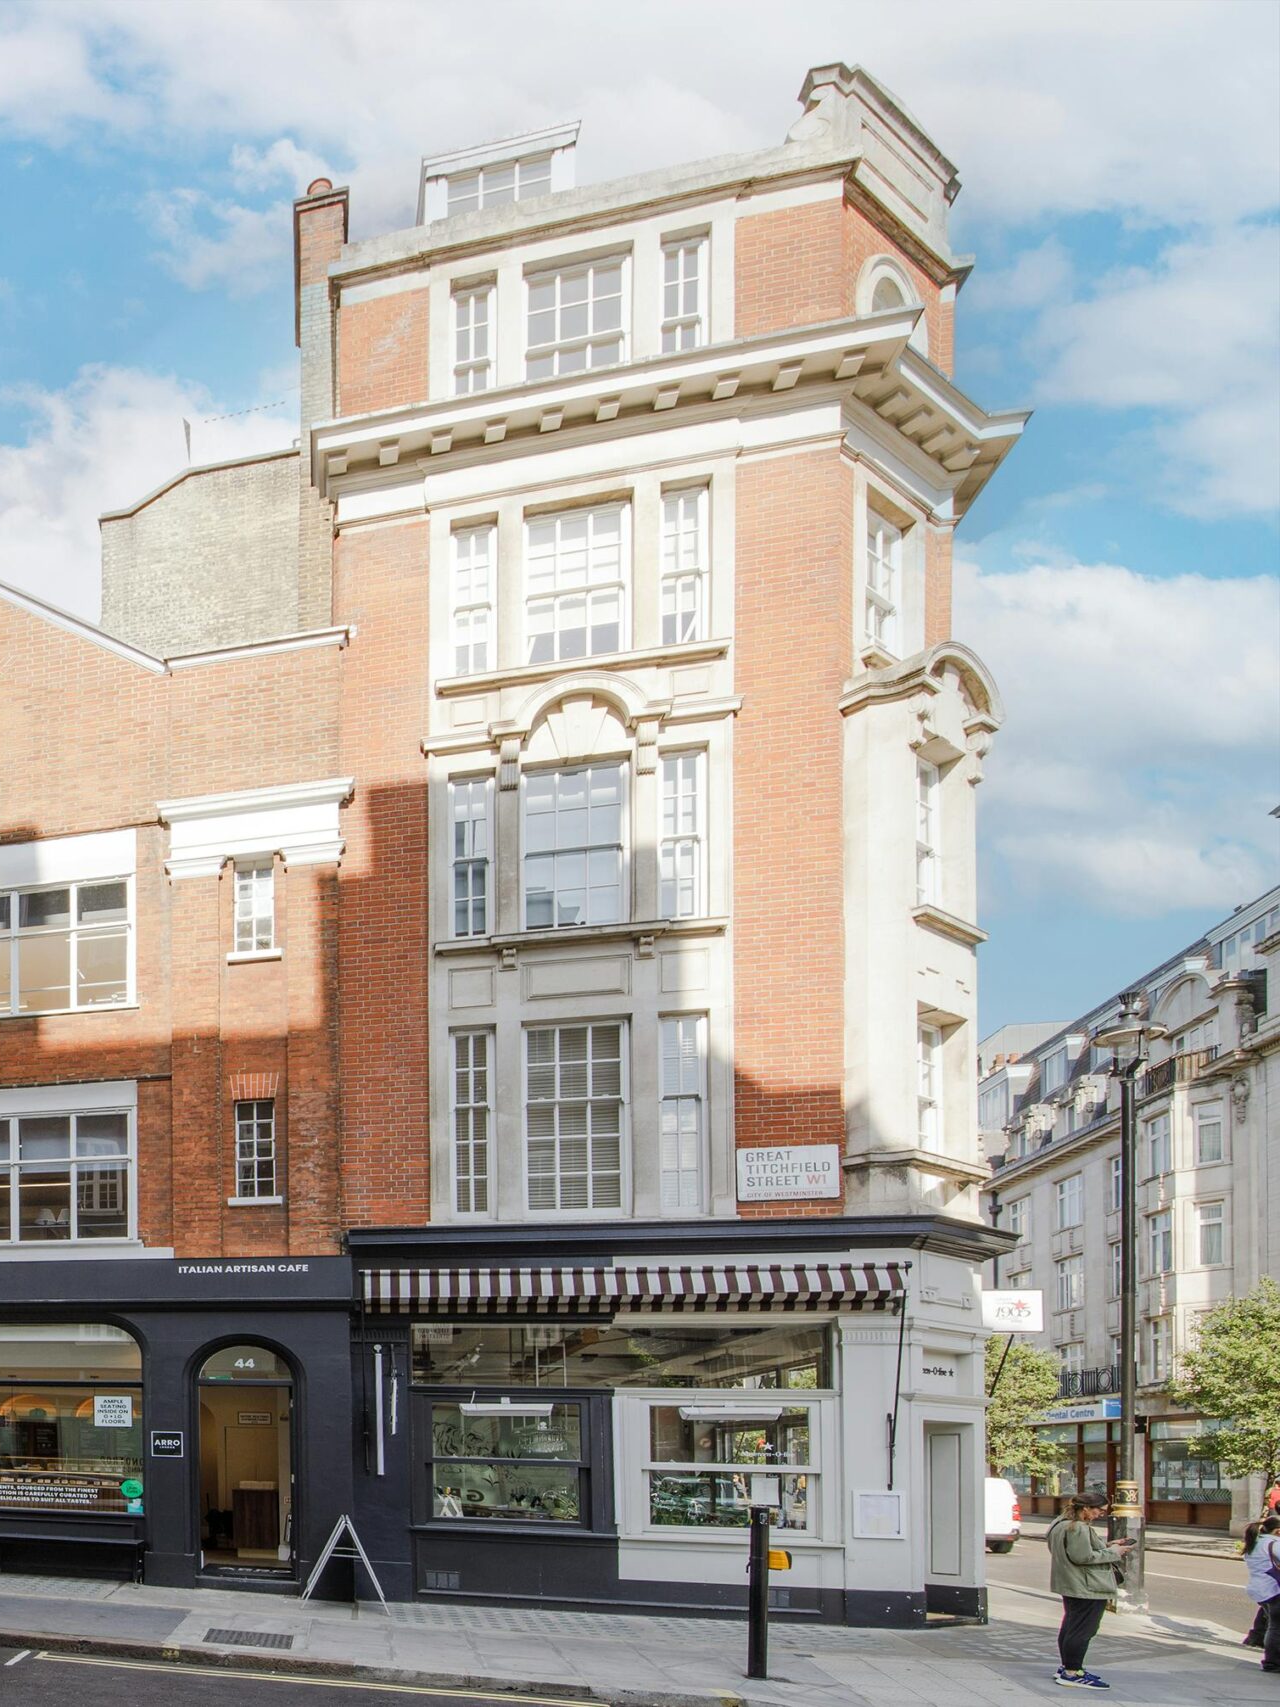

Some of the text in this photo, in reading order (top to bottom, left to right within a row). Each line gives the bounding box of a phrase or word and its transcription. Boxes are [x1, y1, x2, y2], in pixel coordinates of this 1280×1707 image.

[745, 1151, 792, 1162] GREAT
[746, 1161, 831, 1174] TITCHFIELD
[746, 1174, 827, 1187] STREET W1
[178, 1264, 309, 1274] ITALIAN ARTISAN CAFE
[234, 1358, 255, 1368] 44
[1070, 1408, 1095, 1418] Centre
